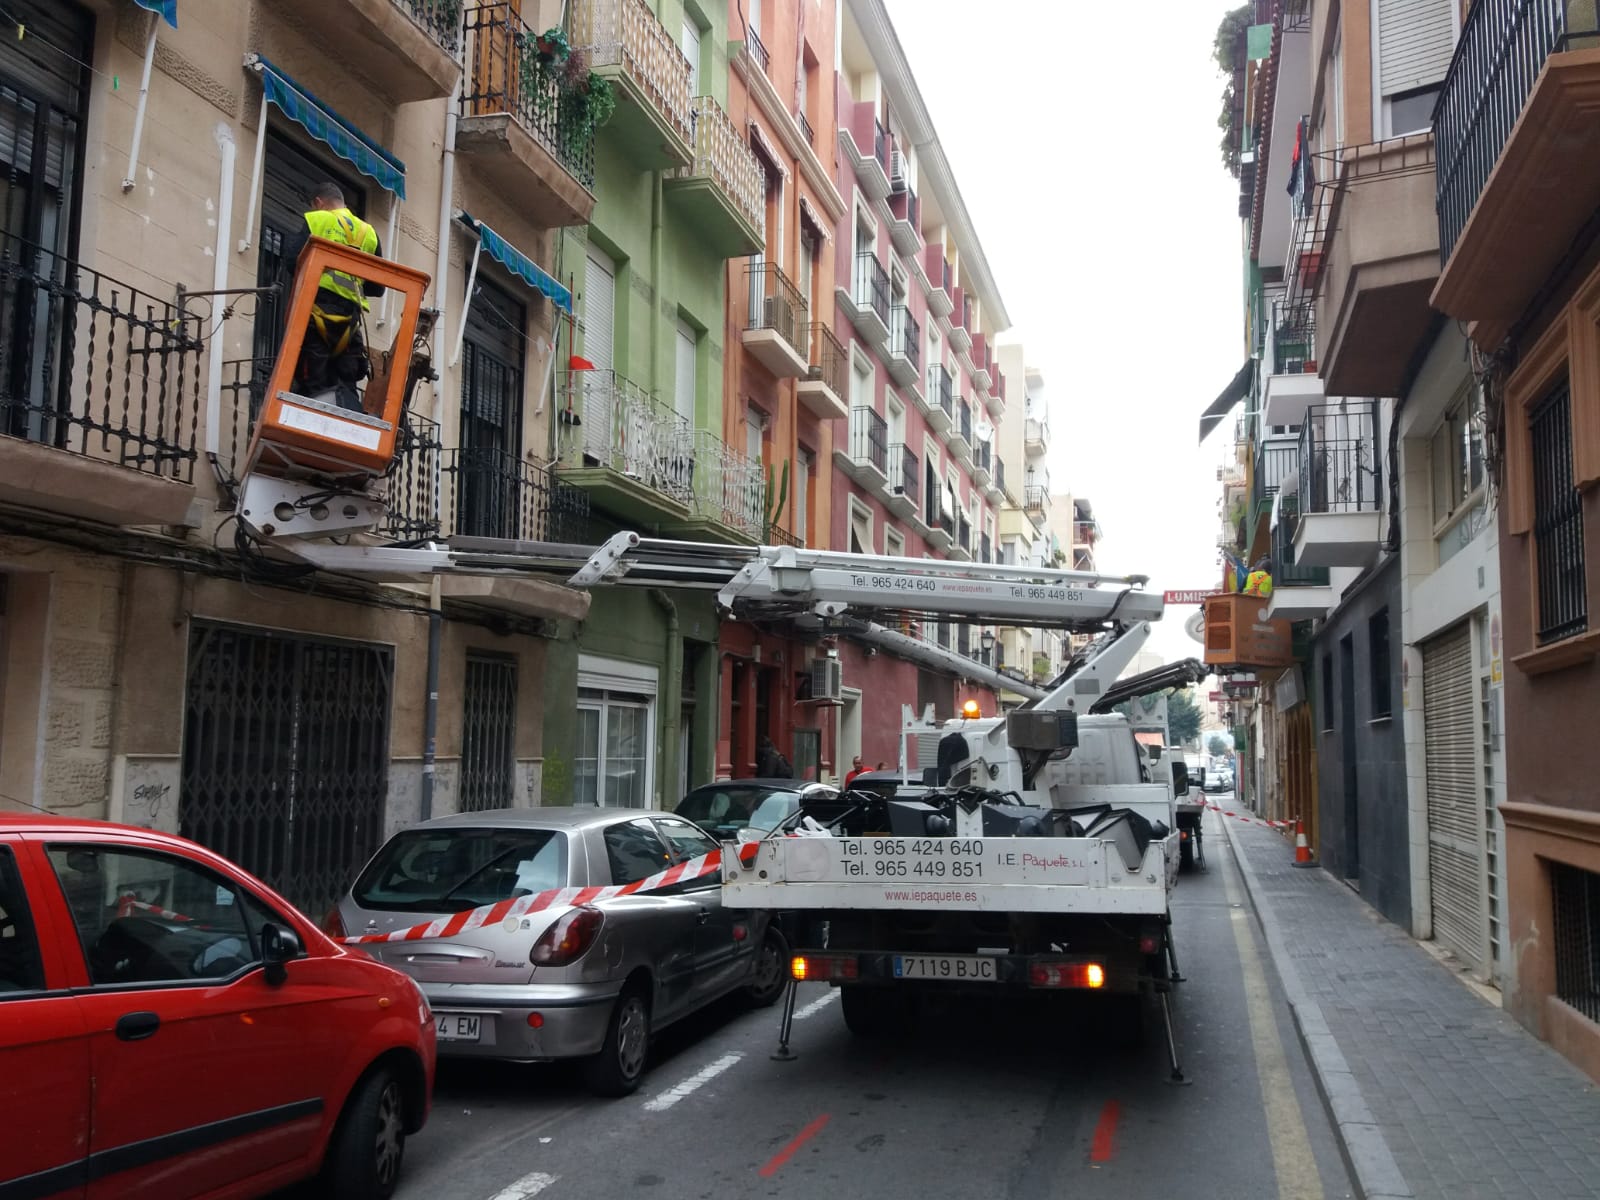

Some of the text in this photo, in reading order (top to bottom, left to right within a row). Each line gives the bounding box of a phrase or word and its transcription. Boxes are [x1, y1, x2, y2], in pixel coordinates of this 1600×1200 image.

[850, 575, 868, 587] Tel.
[872, 576, 891, 588] 965
[894, 578, 914, 590] 424
[916, 579, 936, 591] 640
[1009, 586, 1025, 598] Tel.
[1028, 588, 1045, 599] 965
[1047, 589, 1065, 601] 449
[1067, 590, 1084, 601] 851
[840, 840, 983, 856] Tel. 965 424 640
[840, 860, 983, 877] Tel. 965 449 851
[885, 890, 977, 904] www.iepaquete.es
[905, 959, 992, 978] 7119 BJC
[457, 1017, 478, 1036] EM
